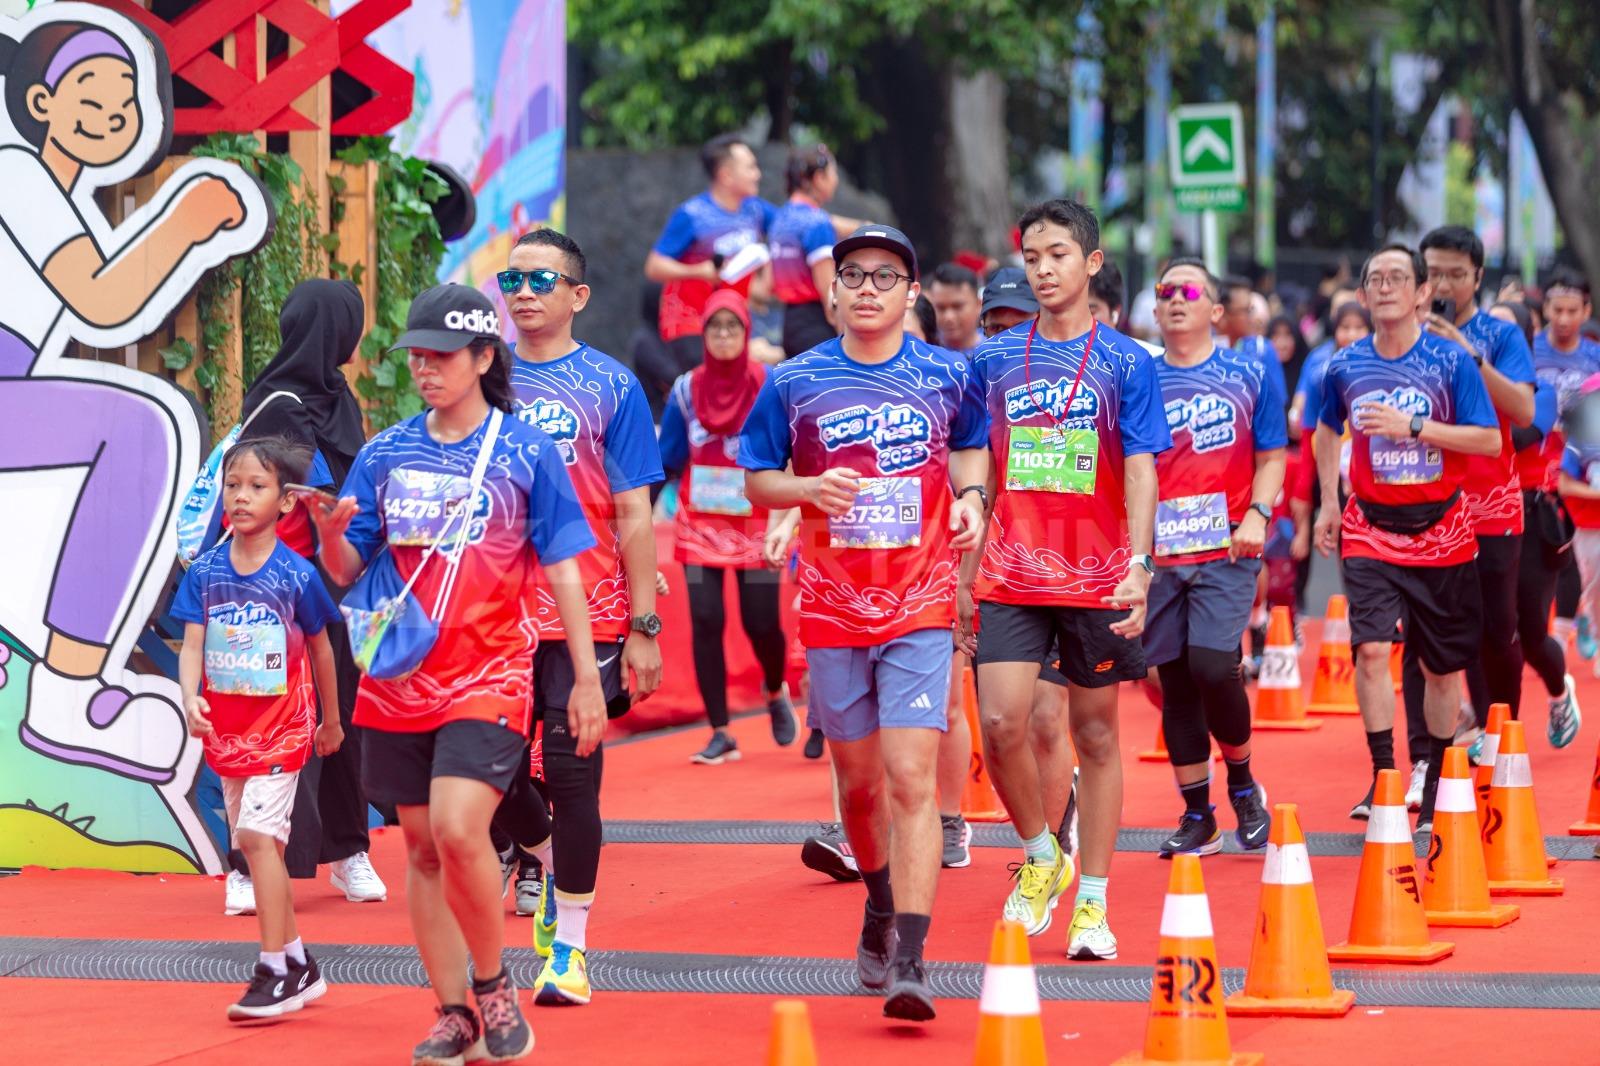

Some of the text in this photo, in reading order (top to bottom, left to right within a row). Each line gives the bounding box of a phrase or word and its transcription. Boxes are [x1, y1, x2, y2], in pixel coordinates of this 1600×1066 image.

[819, 408, 866, 426] PERTAMINA
[879, 446, 924, 468] 2023
[1011, 451, 1067, 470] 11037
[1157, 515, 1210, 537] 50489
[207, 650, 264, 671] 33046
